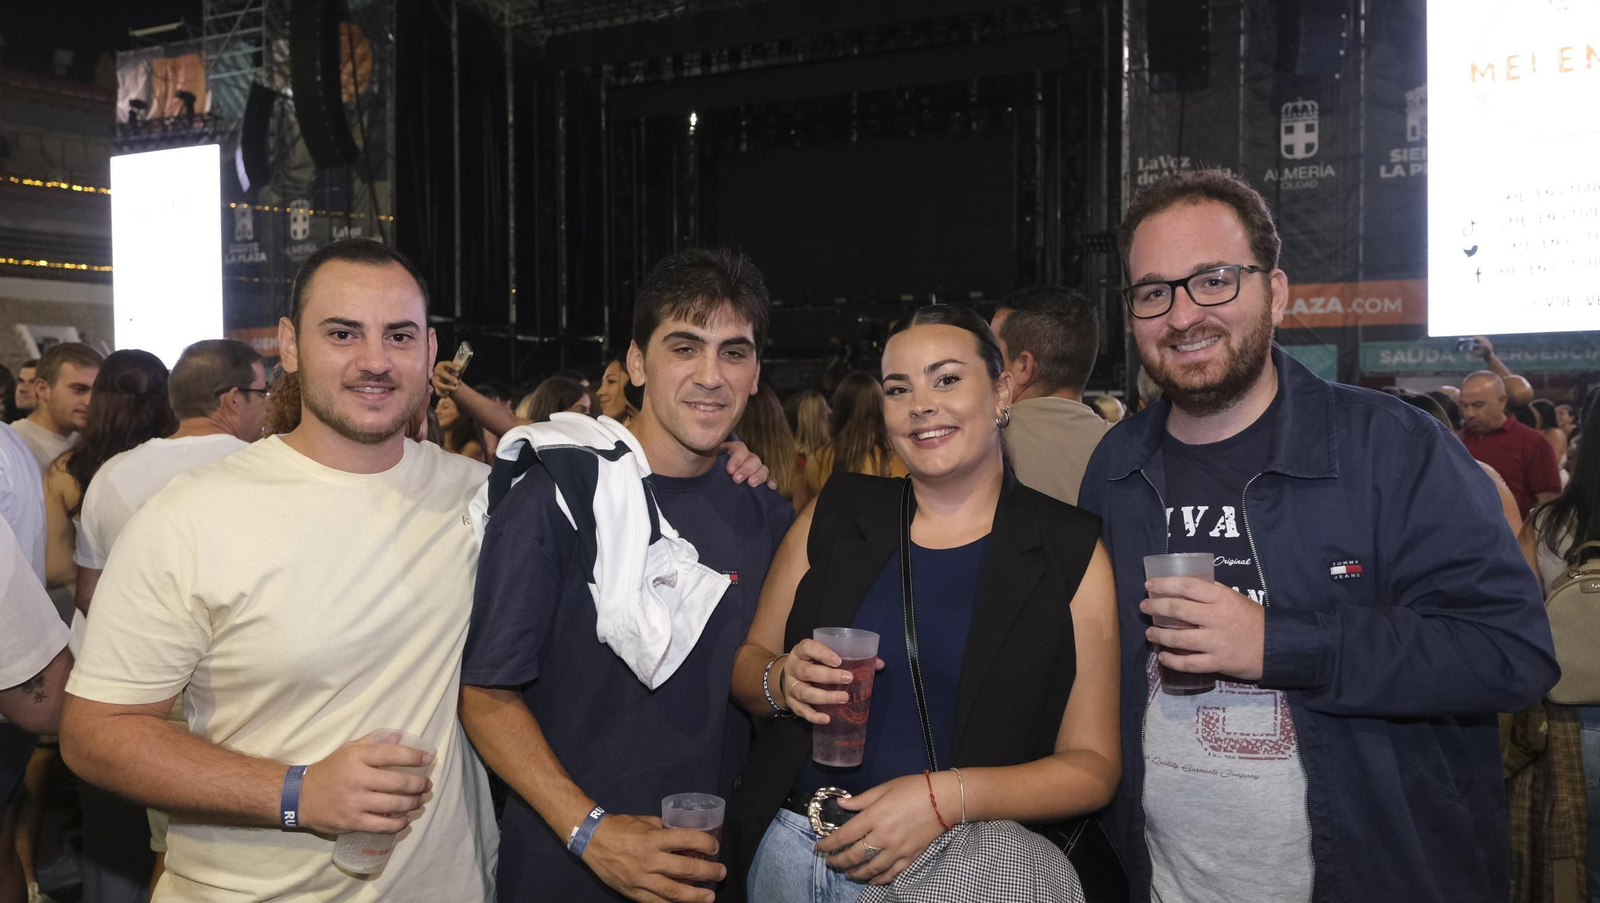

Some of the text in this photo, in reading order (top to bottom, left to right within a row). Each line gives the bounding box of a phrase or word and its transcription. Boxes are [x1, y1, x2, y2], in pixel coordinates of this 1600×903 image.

[1379, 165, 1406, 179] LA
[1213, 555, 1252, 566] Original
[1152, 756, 1180, 769] Quality
[1182, 763, 1218, 775] Garments
[1220, 769, 1261, 780] Company
